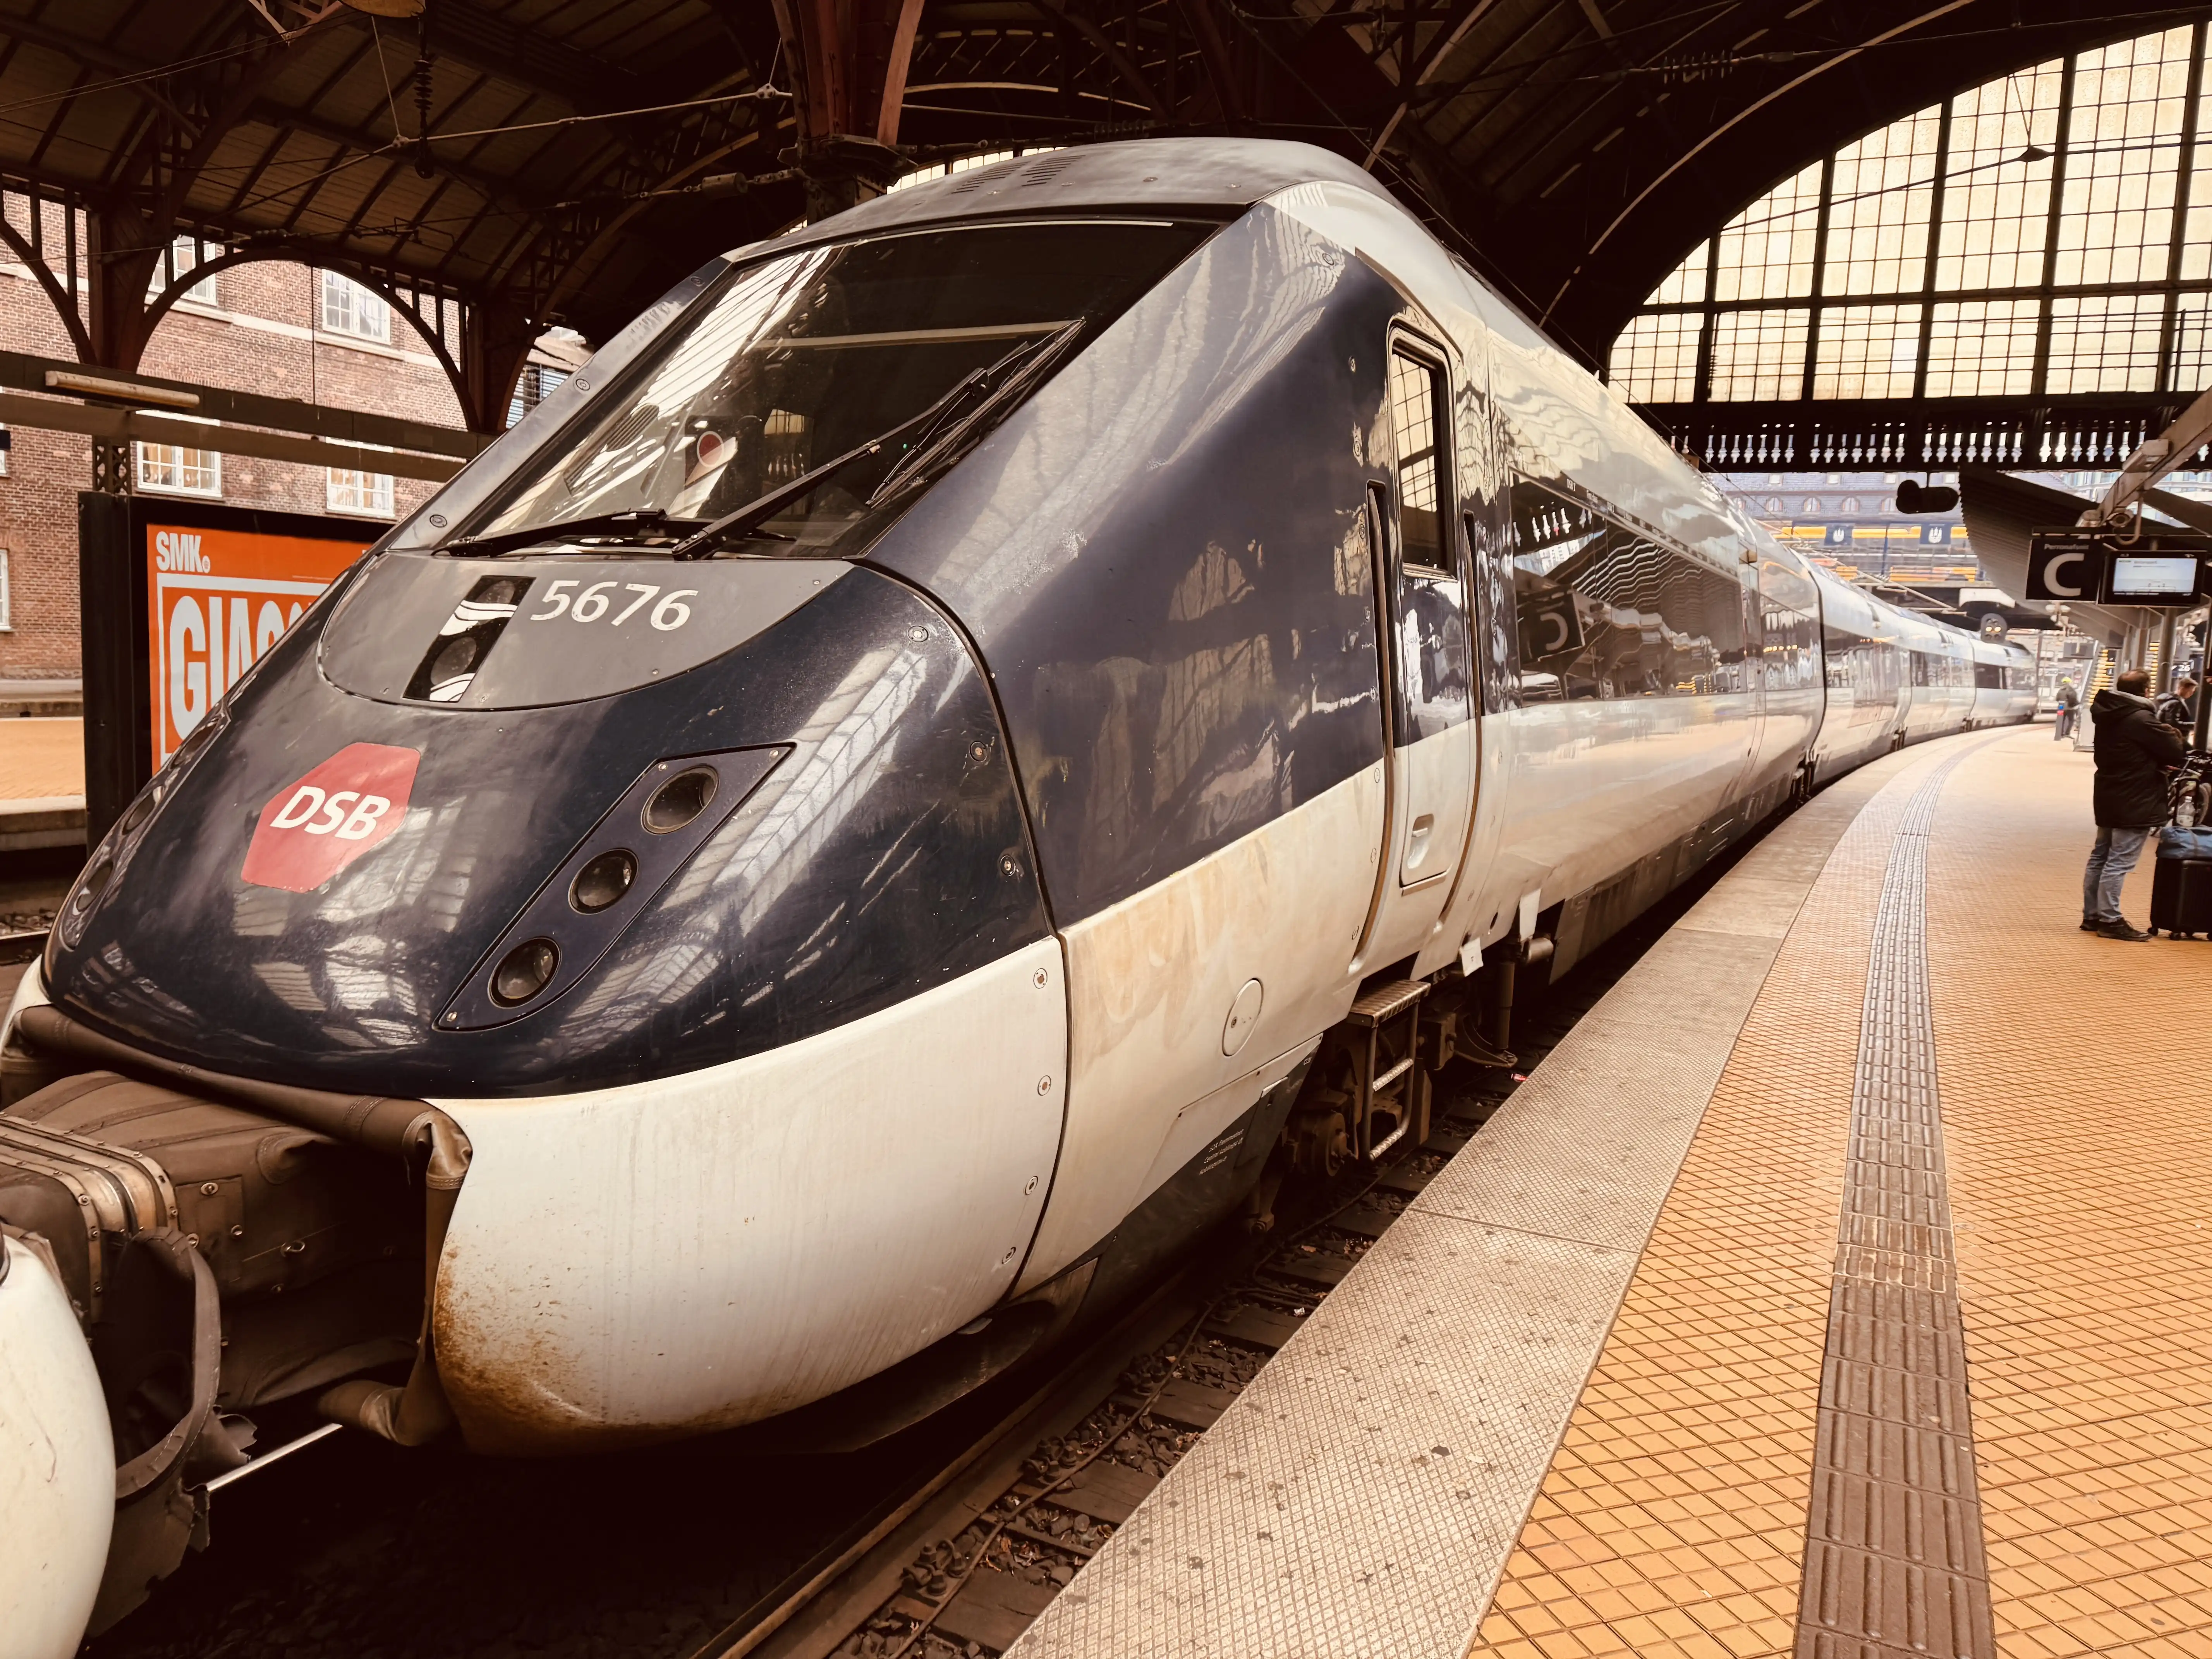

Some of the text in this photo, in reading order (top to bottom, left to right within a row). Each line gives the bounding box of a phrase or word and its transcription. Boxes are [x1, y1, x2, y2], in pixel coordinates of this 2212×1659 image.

[156, 531, 204, 573] SMK
[2043, 553, 2085, 597] C
[530, 580, 699, 631] 5676
[269, 785, 391, 840] DSB
